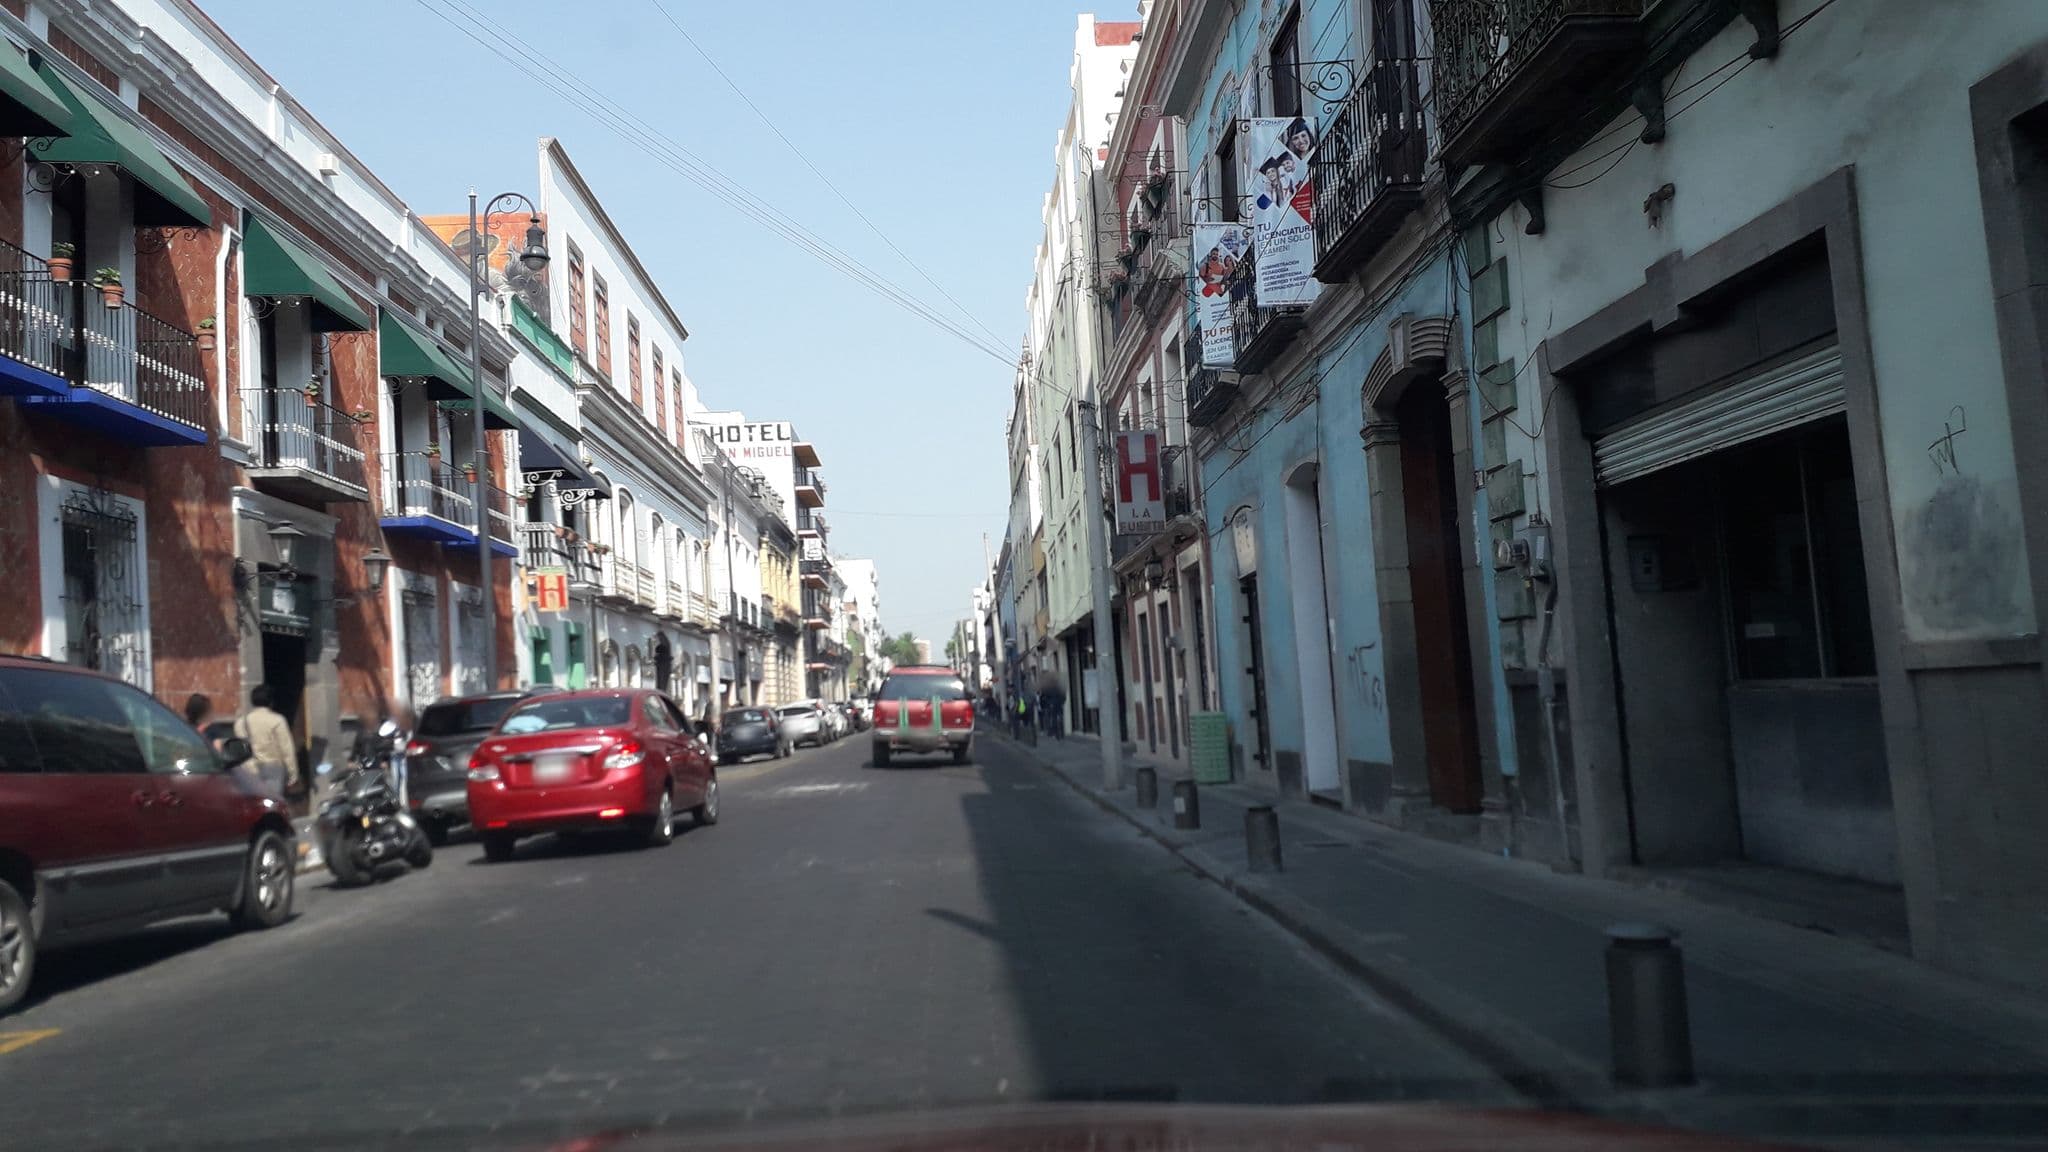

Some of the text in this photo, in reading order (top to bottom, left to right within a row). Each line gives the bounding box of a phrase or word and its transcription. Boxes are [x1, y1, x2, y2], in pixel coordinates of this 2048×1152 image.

[1257, 222, 1271, 232] TU
[1274, 237, 1286, 246] UN
[1288, 232, 1311, 243] SOLO
[1203, 329, 1216, 338] TU
[710, 423, 791, 443] HOTEL
[743, 446, 793, 458] MIGUEL
[1117, 433, 1161, 503] H
[538, 575, 567, 609] H
